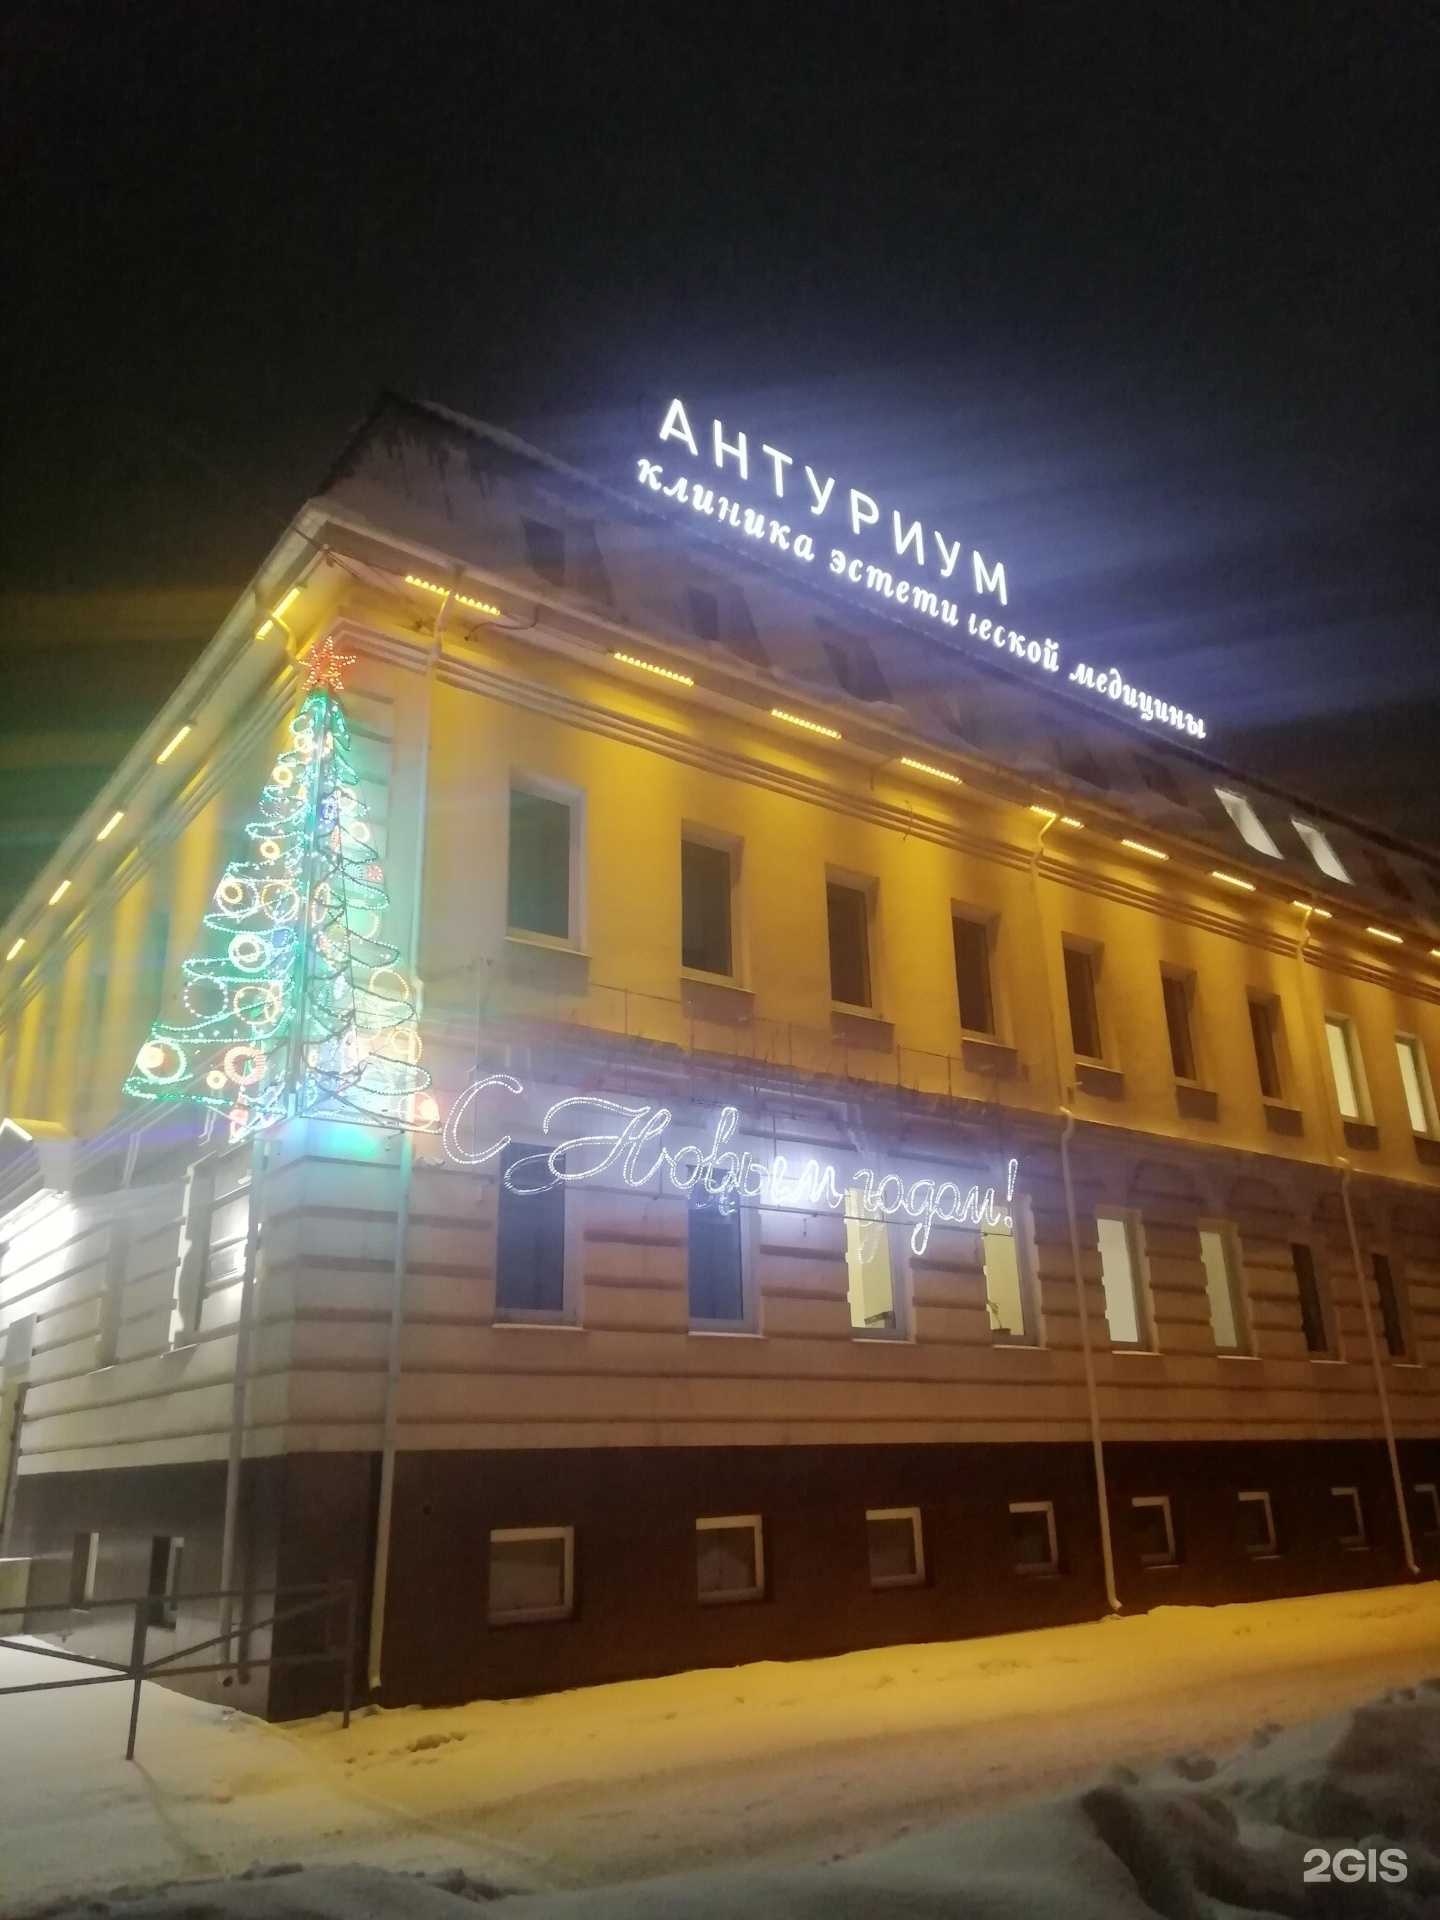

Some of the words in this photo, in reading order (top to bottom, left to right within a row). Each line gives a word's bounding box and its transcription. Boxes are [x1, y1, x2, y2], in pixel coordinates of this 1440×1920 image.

[636, 457, 816, 562] клиника
[1068, 662, 1208, 740] медицины
[658, 398, 1009, 606] АНТУРИУМ
[442, 1073, 524, 1165] С
[542, 1096, 845, 1209] Новым
[853, 1158, 1018, 1256] годом!
